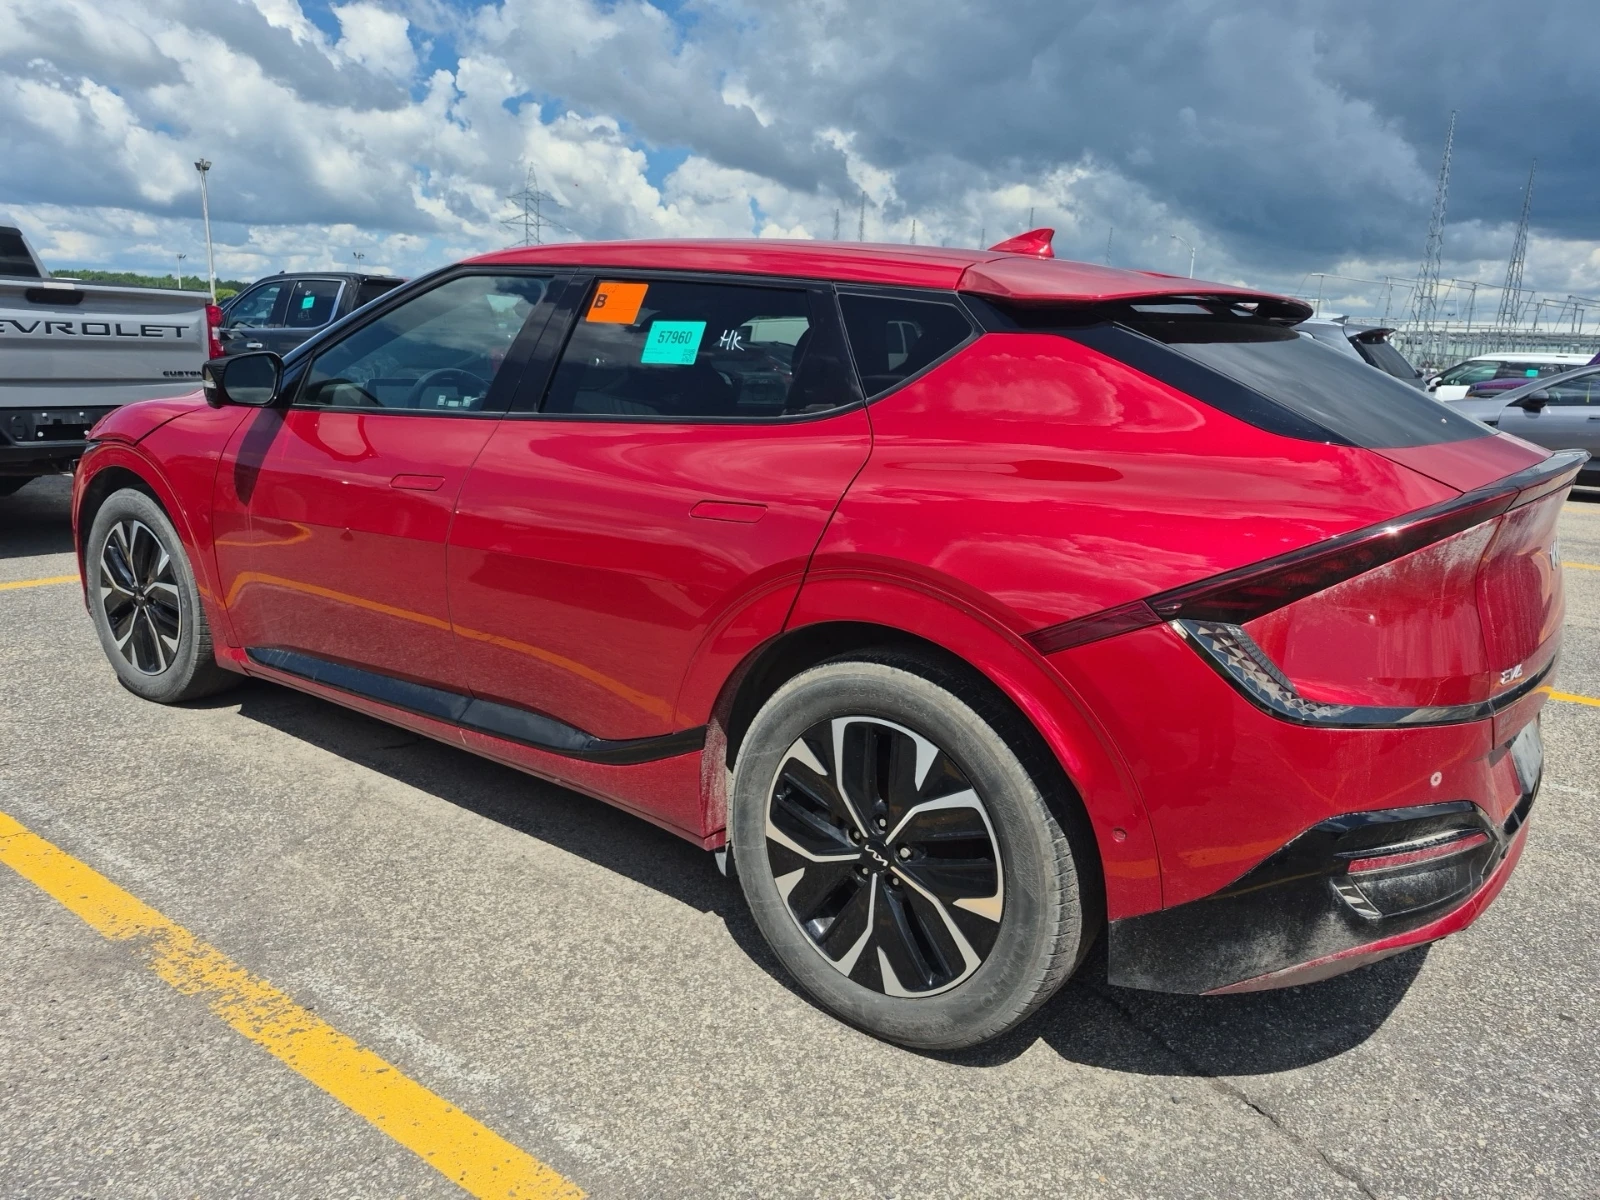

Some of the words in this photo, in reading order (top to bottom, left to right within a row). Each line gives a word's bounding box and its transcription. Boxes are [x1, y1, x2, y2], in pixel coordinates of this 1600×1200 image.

[594, 294, 608, 308] B
[0, 319, 190, 338] VROLET
[657, 330, 693, 344] 57960
